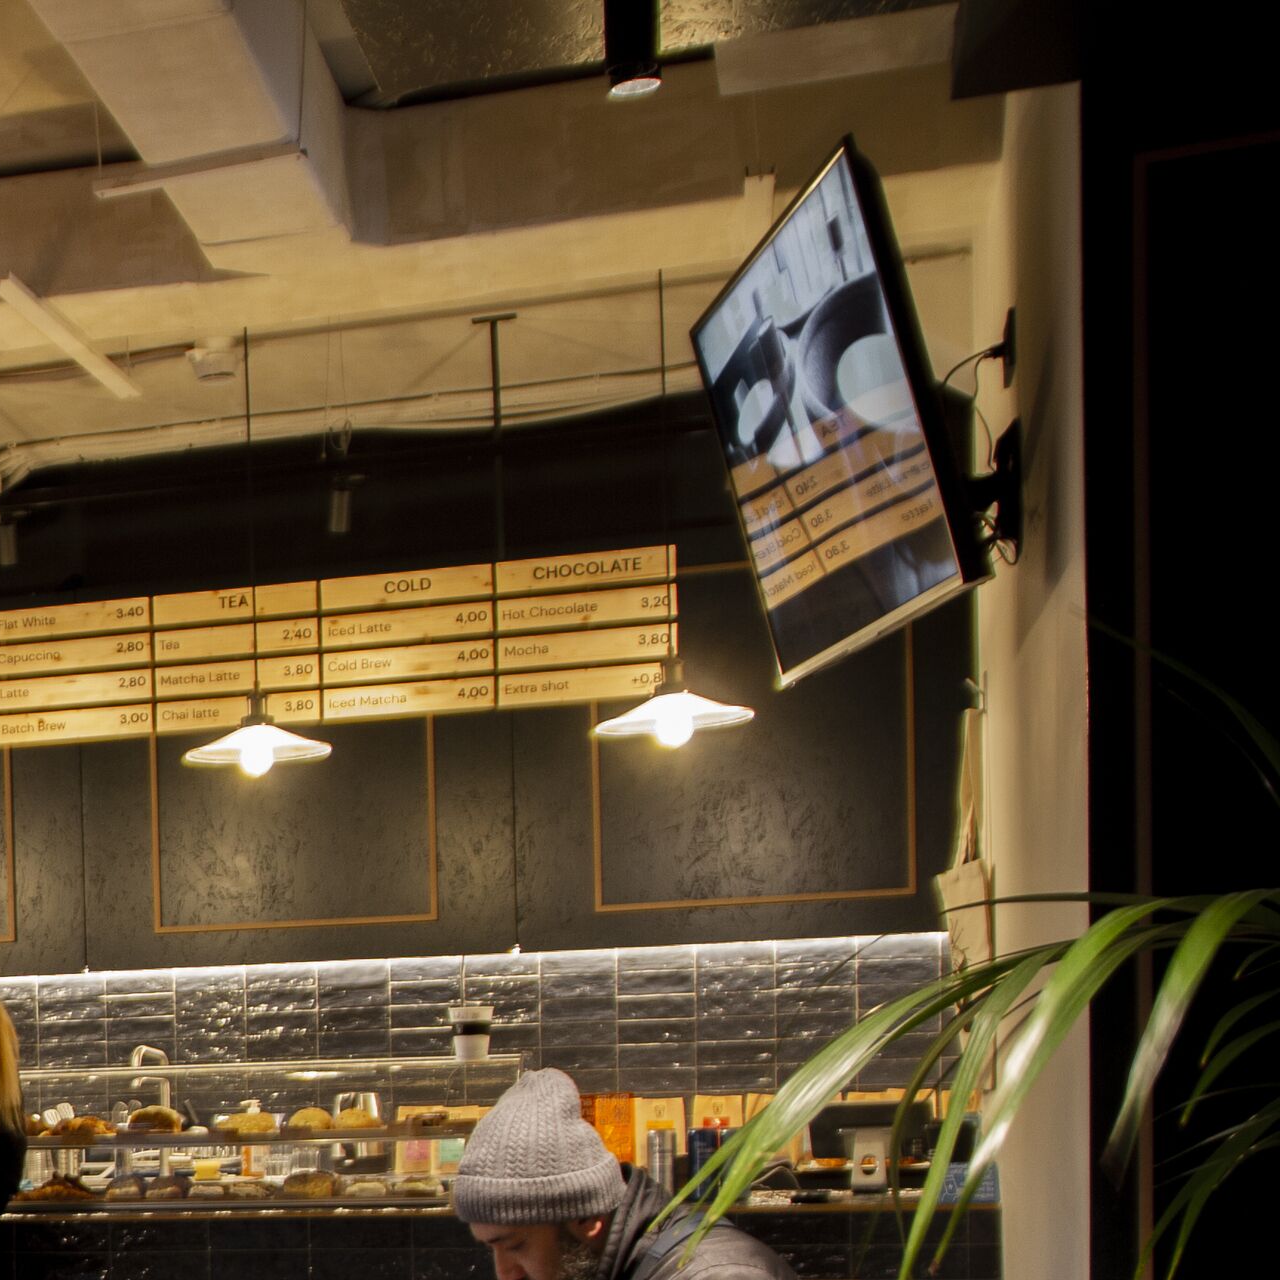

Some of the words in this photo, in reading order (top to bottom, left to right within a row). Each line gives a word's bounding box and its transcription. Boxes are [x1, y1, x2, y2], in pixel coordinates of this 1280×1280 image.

[533, 556, 642, 580] CHOCOLATE
[384, 577, 432, 594] COLD
[218, 595, 248, 609] TEA
[502, 608, 525, 621] Hot
[529, 602, 598, 617] Chocolate
[641, 595, 670, 609] 3,20
[22, 615, 56, 628] White
[359, 622, 391, 634] Latte
[456, 611, 487, 624] 4,00
[116, 641, 144, 654] 2,80
[160, 640, 180, 651] Tea
[282, 628, 312, 641] 2,40
[504, 645, 549, 657] Mocha
[638, 633, 670, 646] 3,80
[328, 659, 357, 672] Cold
[361, 658, 392, 668] Brew
[457, 648, 489, 662] 4,00
[160, 673, 205, 686] Matcha
[209, 670, 240, 682] Latte
[284, 664, 313, 676] 3,80
[504, 682, 537, 695] Extra
[541, 680, 569, 692] shot
[631, 672, 663, 686] +0,8
[0, 687, 29, 699] Latte
[119, 676, 146, 689] 2,80
[360, 694, 407, 706] Matcha
[458, 686, 489, 699] 4,00
[162, 709, 189, 721] Chai
[192, 708, 220, 719] latte
[285, 699, 313, 712] 3,80
[2, 722, 34, 735] Batch
[38, 720, 66, 731] Brew
[120, 712, 149, 725] 3,00
